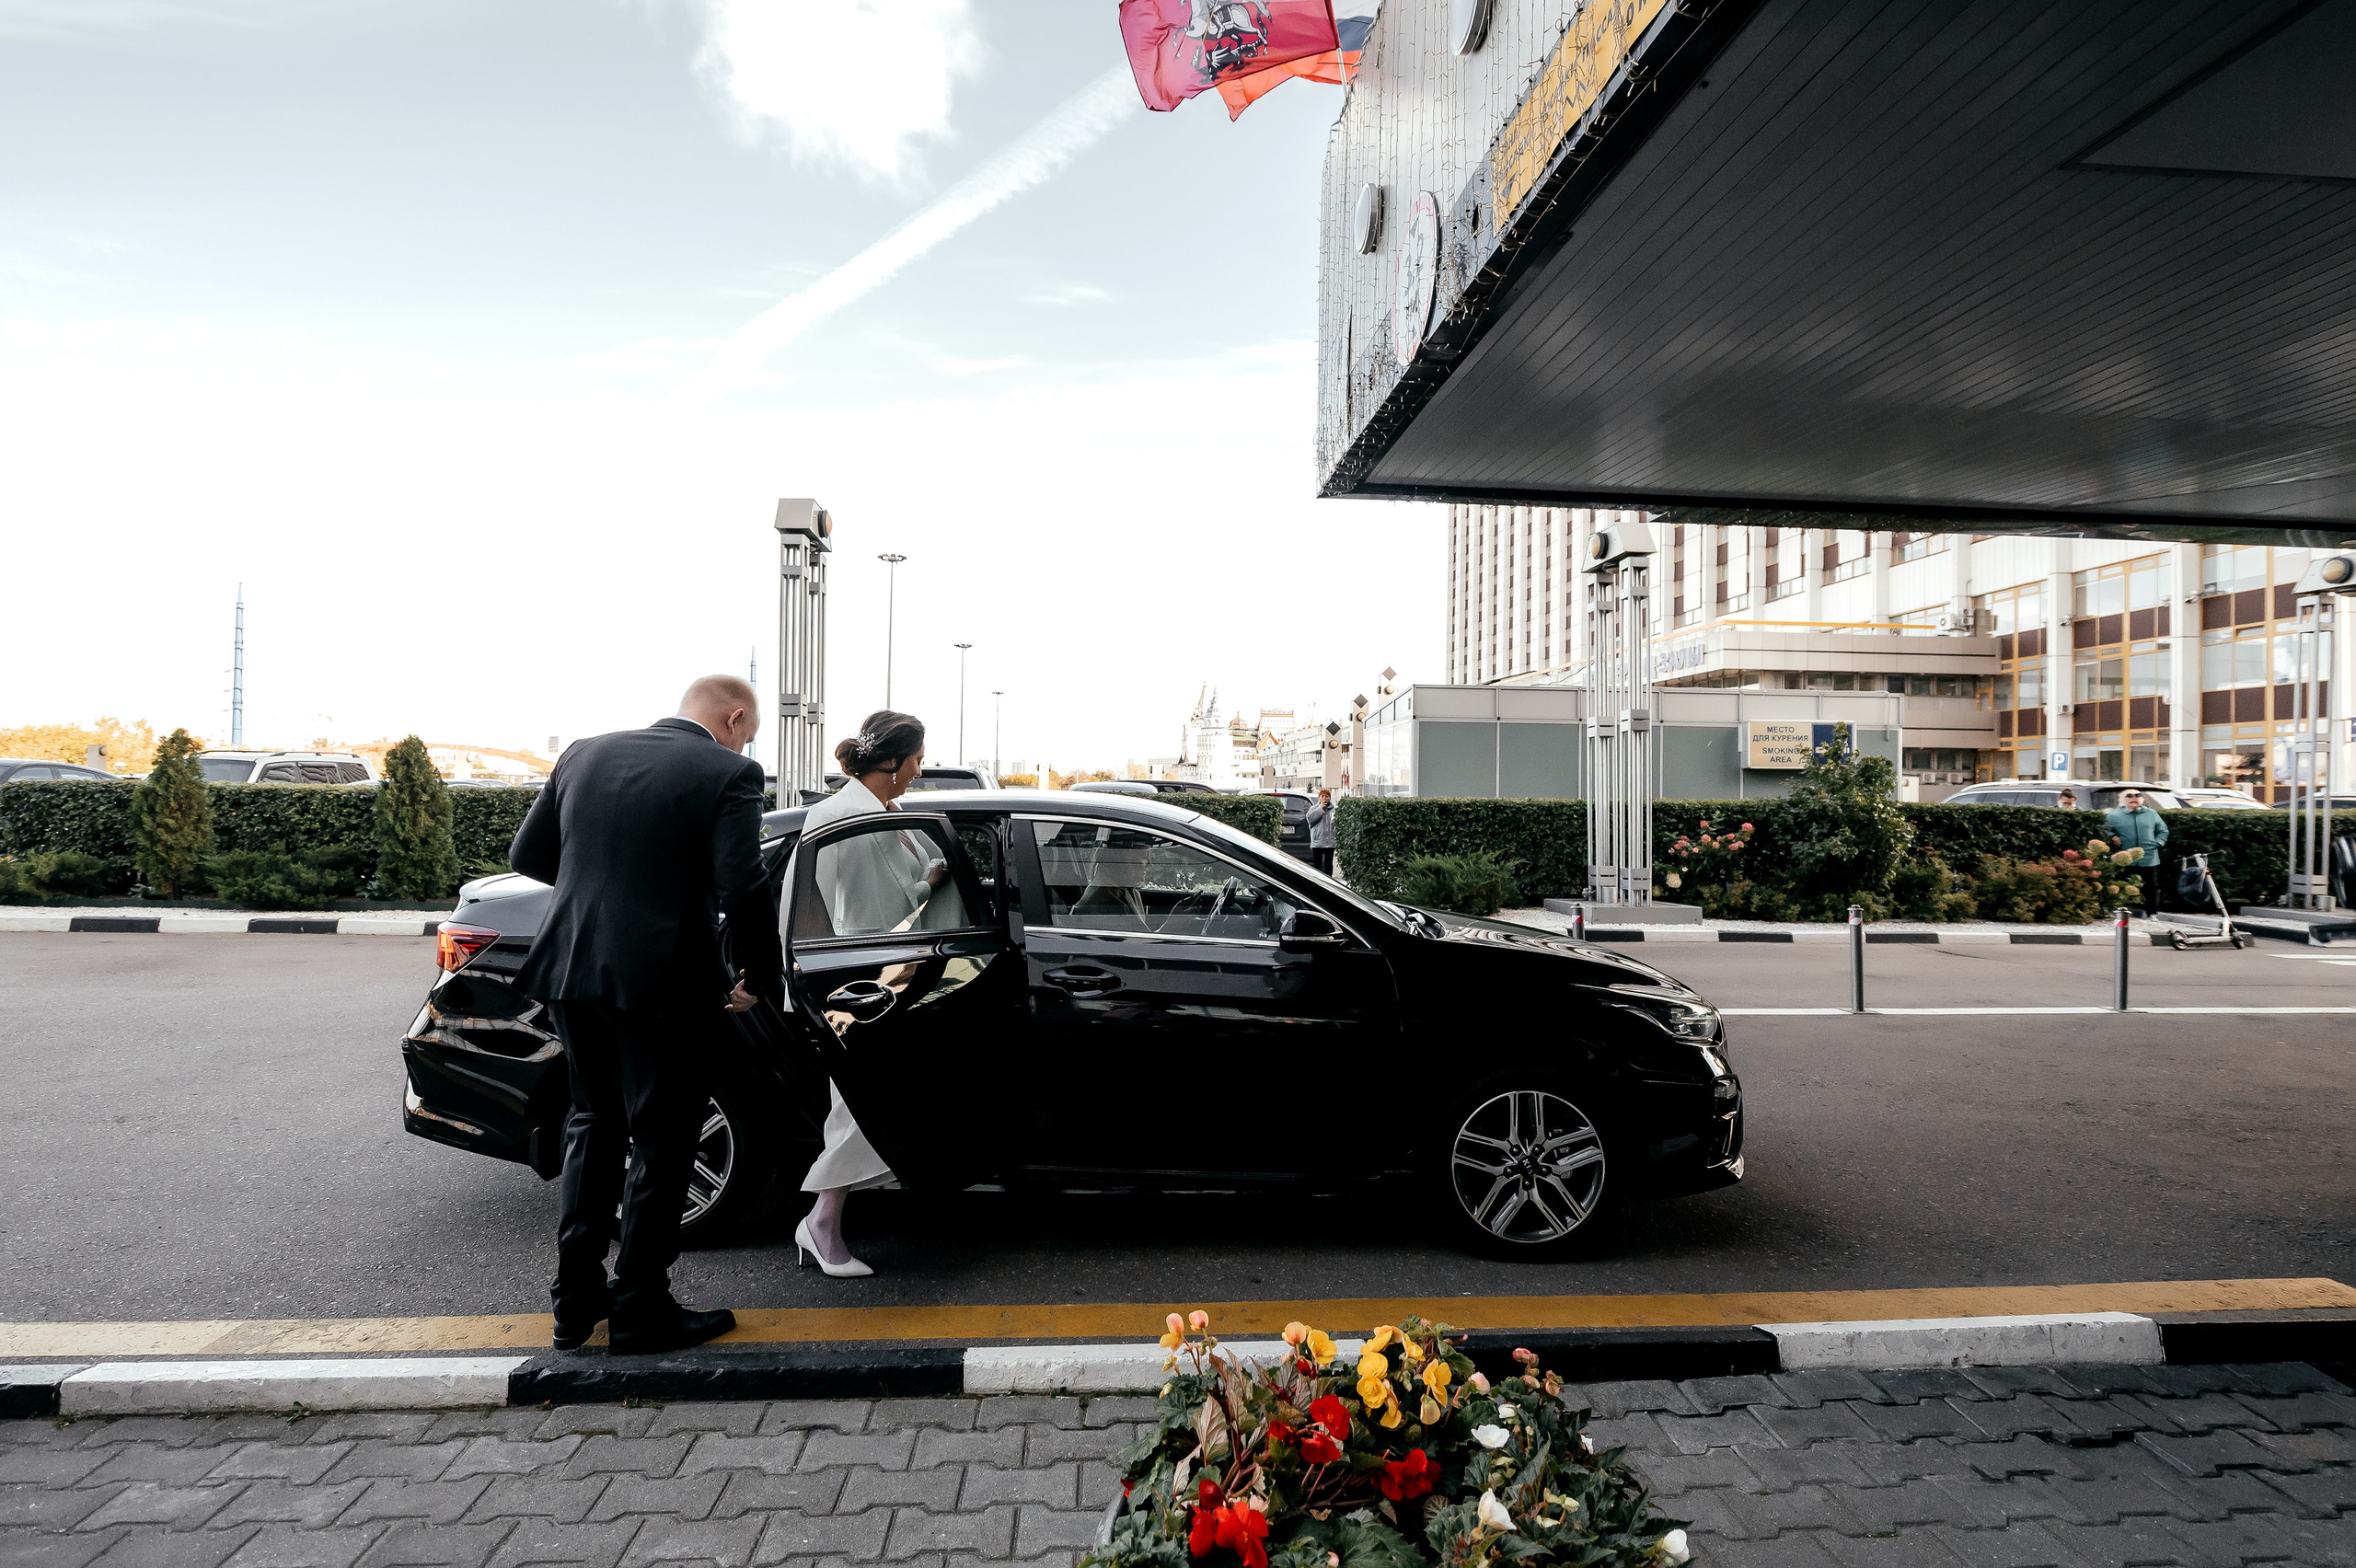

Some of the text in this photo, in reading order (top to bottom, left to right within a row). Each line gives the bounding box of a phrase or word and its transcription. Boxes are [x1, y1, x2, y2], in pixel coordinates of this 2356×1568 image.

[1752, 734, 1770, 743] ДЛЯ
[2053, 754, 2065, 769] P
[1523, 1159, 1533, 1175] KIA
